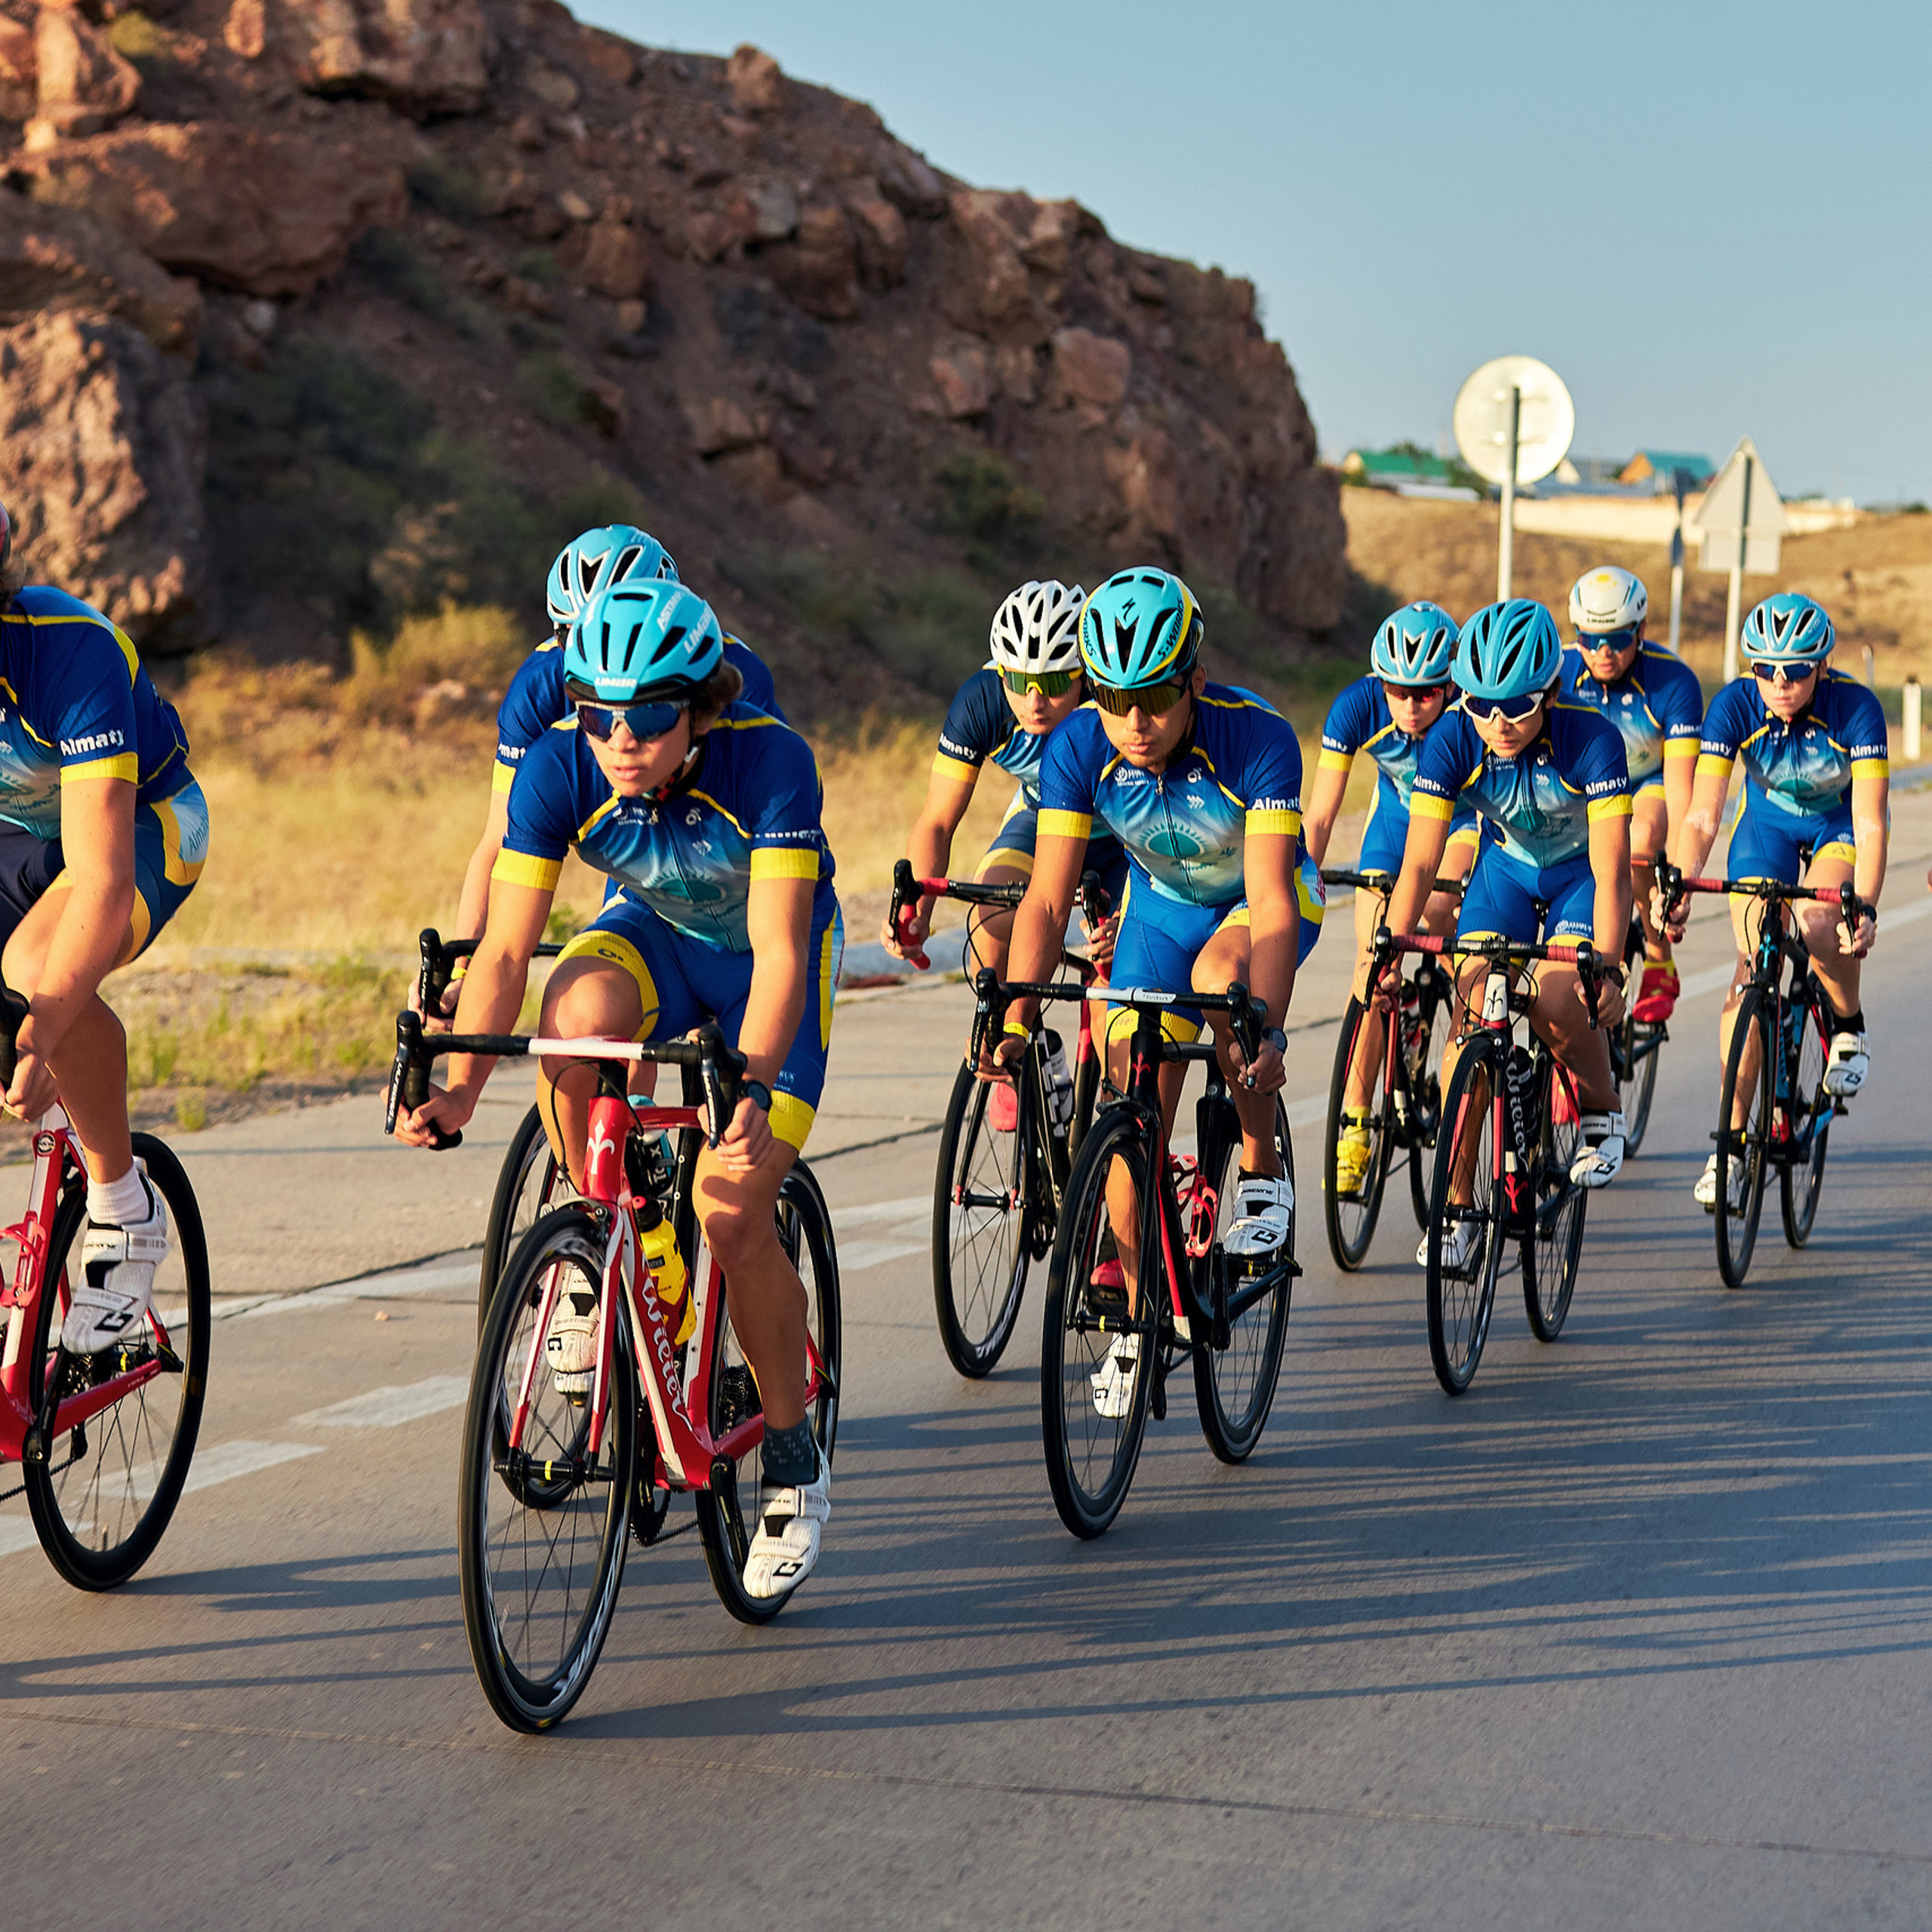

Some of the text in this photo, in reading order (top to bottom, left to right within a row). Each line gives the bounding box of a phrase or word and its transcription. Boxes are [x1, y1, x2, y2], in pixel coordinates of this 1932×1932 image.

[1157, 595, 1184, 663] S-WORKS
[60, 728, 125, 756] Almaty
[1586, 776, 1627, 796] Almaty
